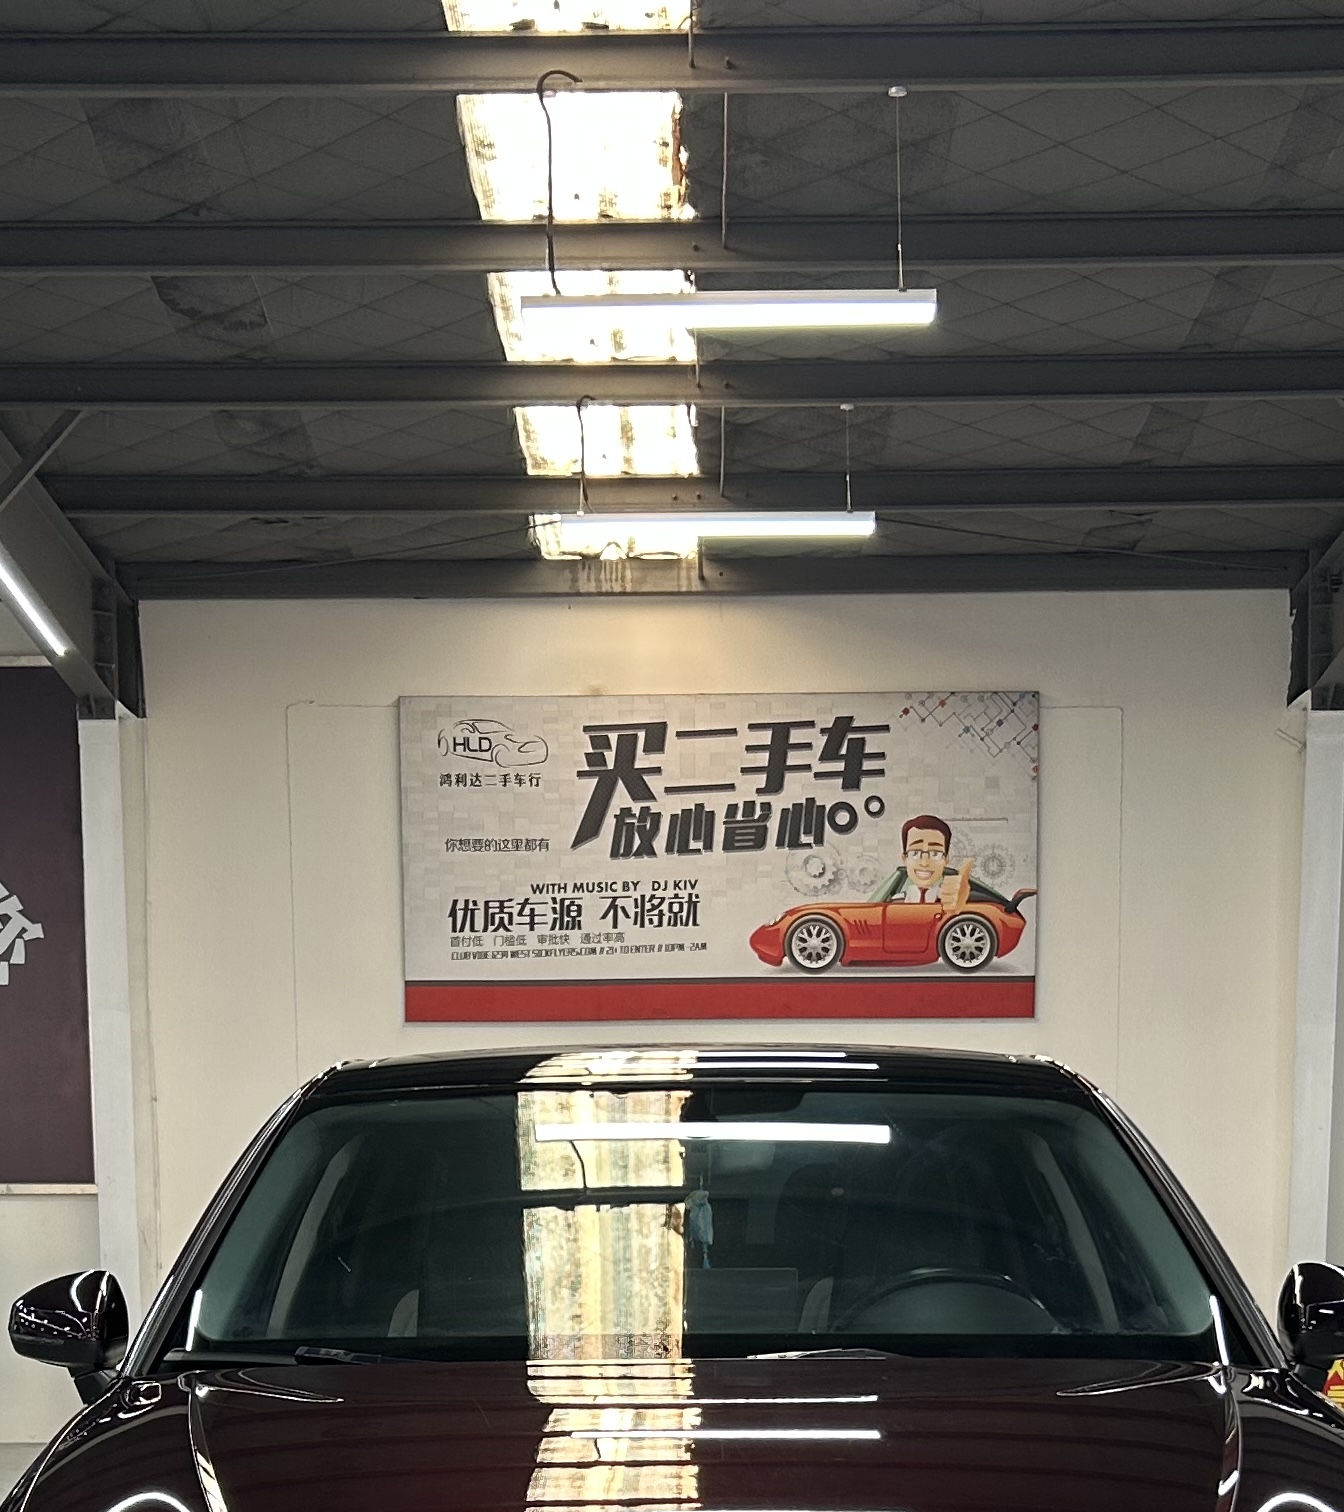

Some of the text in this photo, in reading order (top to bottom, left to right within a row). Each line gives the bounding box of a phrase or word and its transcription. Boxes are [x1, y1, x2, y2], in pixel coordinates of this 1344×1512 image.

[452, 736, 493, 753] HLD
[439, 772, 542, 788] 鸿利达二手车行
[569, 715, 890, 851] 买二手车
[609, 796, 827, 861] 放心省心
[445, 838, 550, 853] 你想要的这里都有
[530, 879, 699, 895] WITH MUSIC BY DJ KIV
[447, 893, 702, 934] 优质车源 不将就
